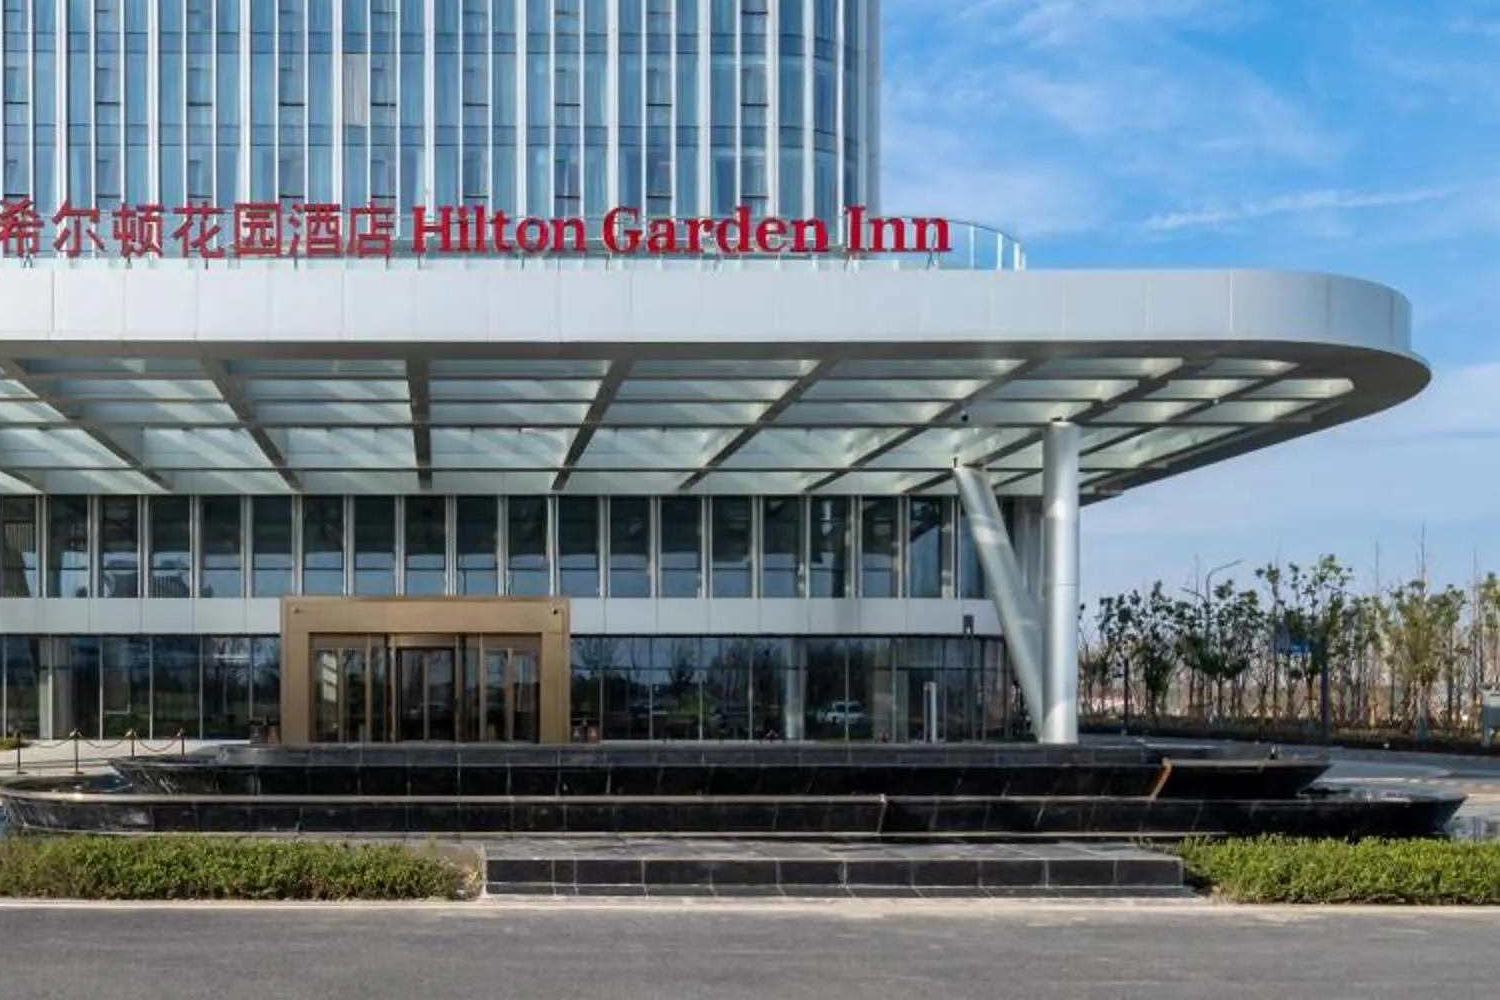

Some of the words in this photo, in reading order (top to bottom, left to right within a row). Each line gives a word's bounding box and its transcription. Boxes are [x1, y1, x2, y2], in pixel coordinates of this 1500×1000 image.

[412, 205, 588, 254] Hilton
[603, 206, 829, 254] Garden
[843, 205, 952, 253] Inn
